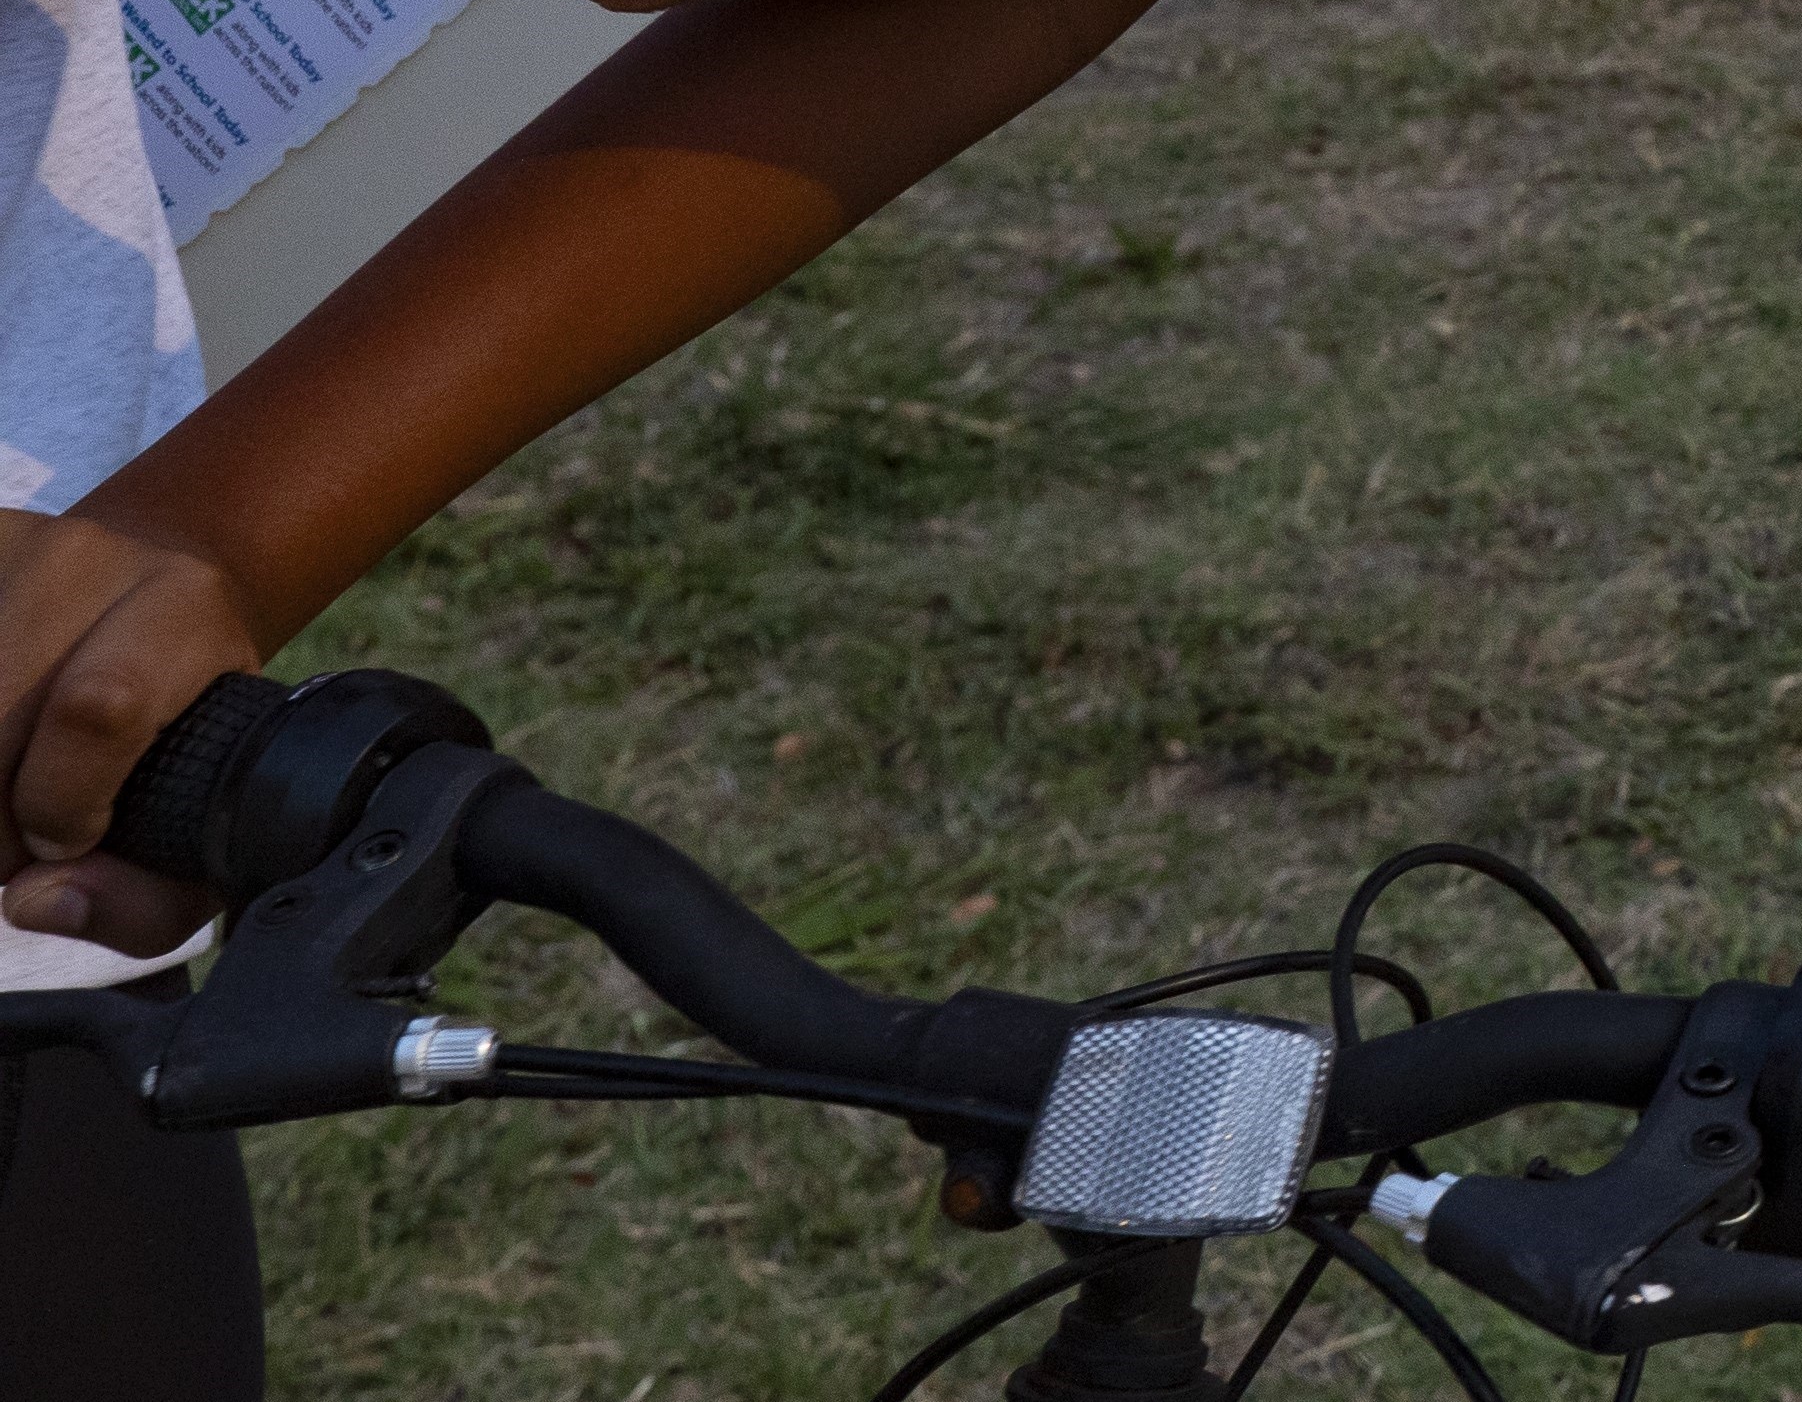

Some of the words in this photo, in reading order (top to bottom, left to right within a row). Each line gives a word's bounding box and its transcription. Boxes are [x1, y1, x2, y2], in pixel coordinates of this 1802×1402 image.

[230, 22, 260, 55] along
[257, 50, 281, 76] with
[278, 73, 300, 97] kids
[249, 1, 291, 46] School
[288, 43, 323, 84] Today
[330, 12, 368, 50] nation!
[352, 10, 373, 35] kids
[122, 0, 166, 50] Walked
[161, 47, 177, 66] to
[174, 63, 217, 109] School
[213, 105, 249, 146] Today
[212, 26, 243, 59] across
[240, 55, 259, 76] the
[256, 74, 295, 112] nation!
[137, 89, 168, 121] across
[165, 118, 184, 138] the
[182, 137, 221, 173] nation!
[155, 84, 185, 116] along
[182, 113, 207, 138] with
[204, 135, 226, 160] kids
